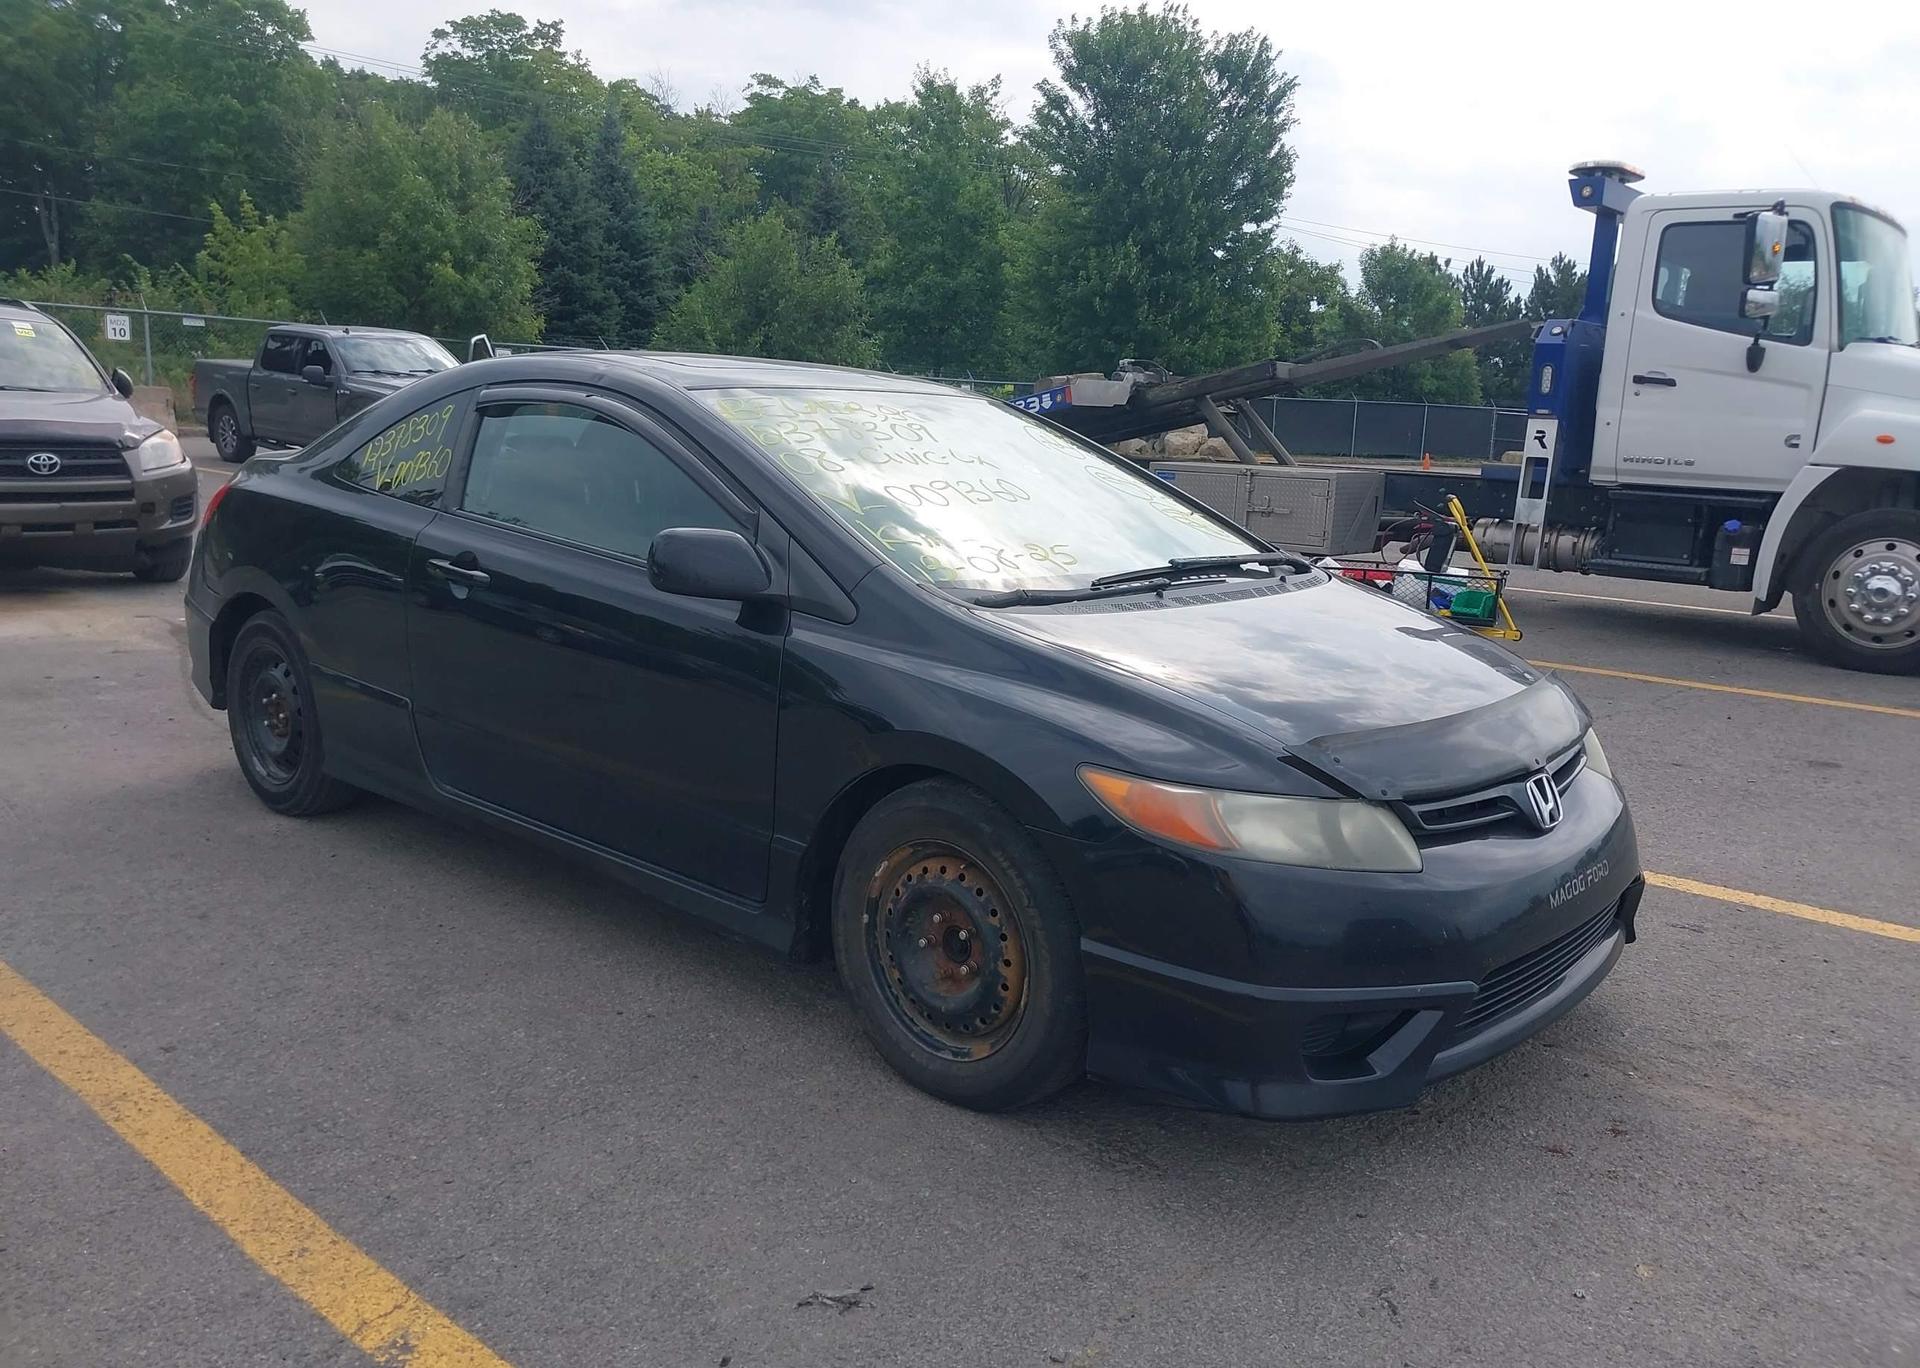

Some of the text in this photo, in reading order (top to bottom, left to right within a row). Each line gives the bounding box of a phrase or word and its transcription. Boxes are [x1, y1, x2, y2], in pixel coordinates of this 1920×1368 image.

[111, 327, 127, 338] 10
[362, 404, 455, 470] 12378309
[1549, 860, 1610, 909] MAGOG FORD
